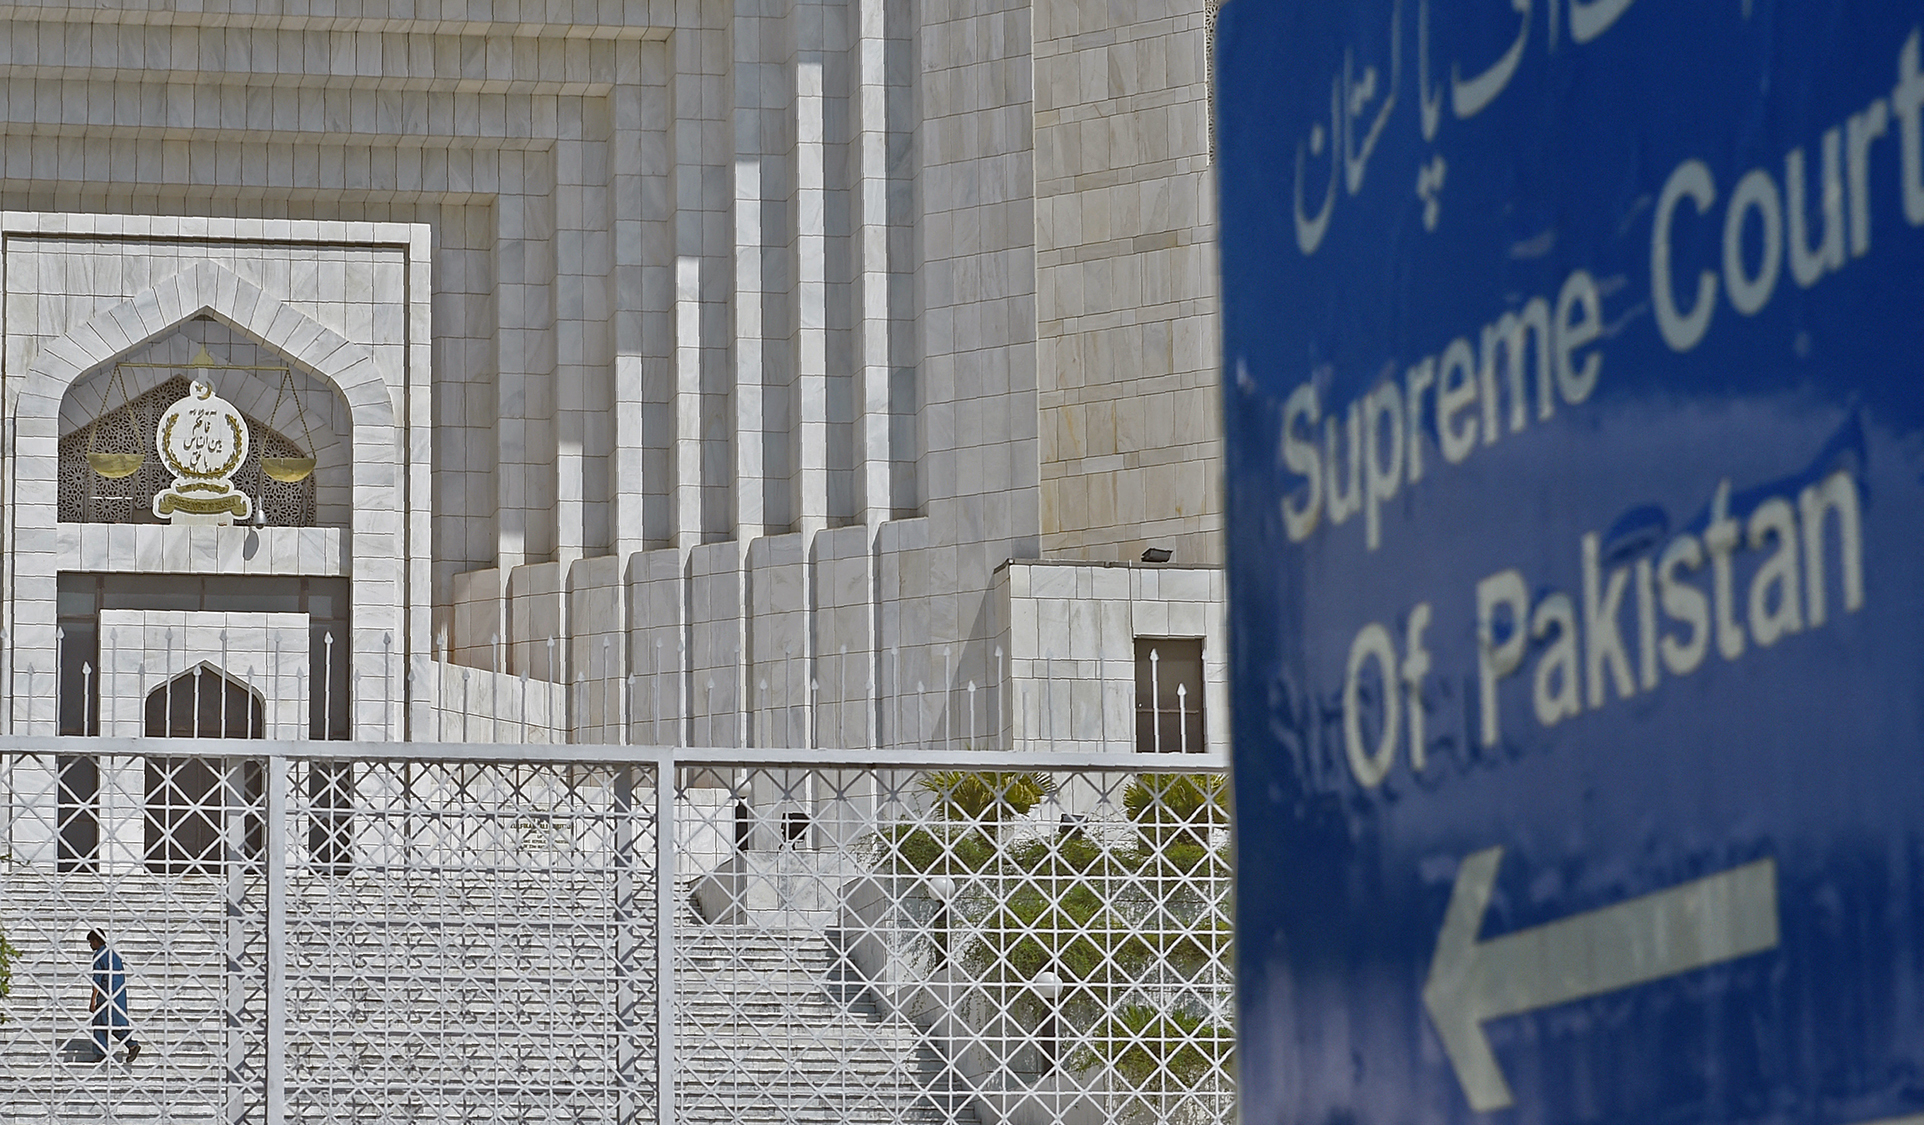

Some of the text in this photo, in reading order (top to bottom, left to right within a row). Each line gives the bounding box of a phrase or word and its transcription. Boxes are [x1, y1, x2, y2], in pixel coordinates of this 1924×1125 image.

[1281, 24, 1924, 551] Supreme Court
[1343, 602, 1431, 788] Of
[1477, 470, 1863, 747] Pakistan
